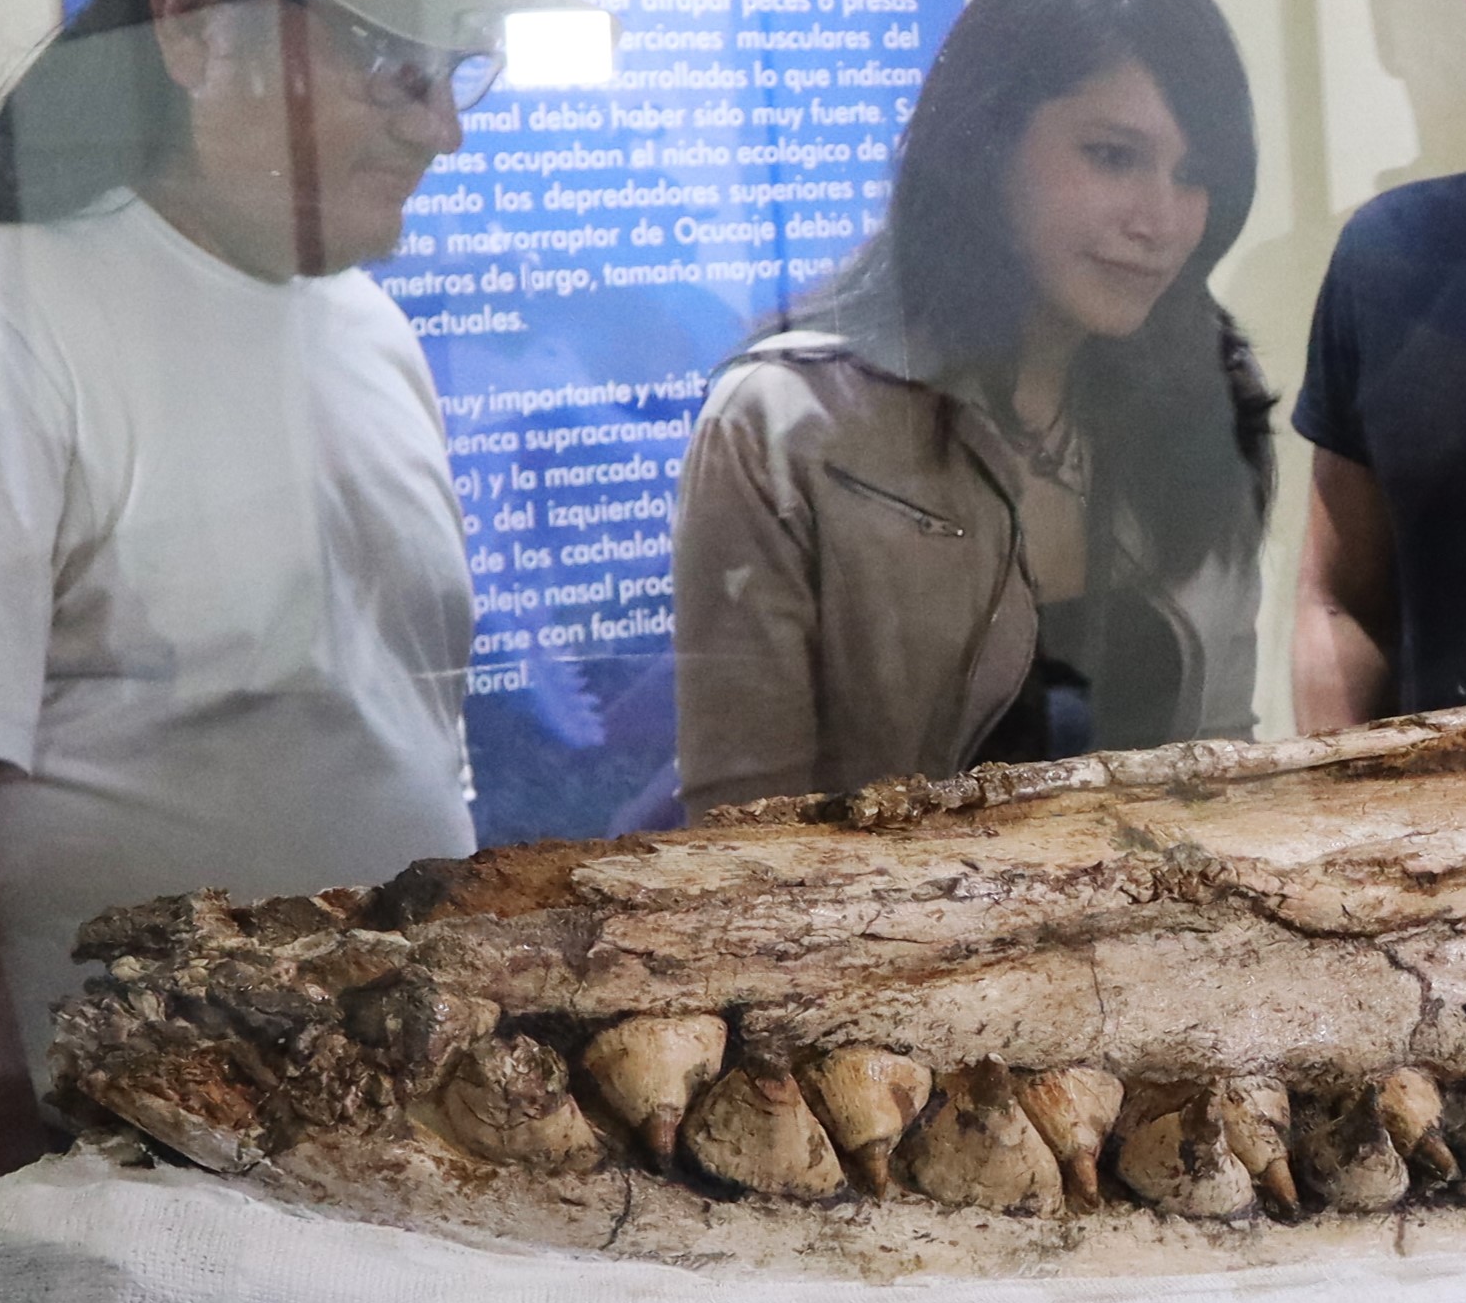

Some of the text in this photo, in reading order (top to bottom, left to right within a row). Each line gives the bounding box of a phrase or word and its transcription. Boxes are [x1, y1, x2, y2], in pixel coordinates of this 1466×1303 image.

[620, 22, 919, 51] erciones musculares del
[754, 60, 777, 88] lo
[784, 68, 830, 93] que
[837, 60, 923, 88] indican
[529, 102, 603, 131] debió
[610, 101, 686, 130] haber
[693, 99, 744, 127] sido
[752, 106, 804, 131] muy
[810, 97, 886, 126] fuerte.
[493, 141, 624, 177] ocupaban
[630, 140, 654, 169] el
[662, 138, 730, 167] nicho
[737, 136, 851, 170] ecológico
[857, 134, 887, 161] de
[402, 184, 483, 216] iendo
[494, 182, 532, 212] los
[543, 177, 719, 215] depredadores
[729, 175, 854, 209] superiores
[448, 224, 620, 254] macrorraptor
[631, 217, 664, 245] de
[674, 215, 776, 246] Ocucaje
[785, 212, 853, 239] debió
[383, 271, 475, 297] metros
[481, 264, 515, 292] de
[603, 259, 701, 286] tamaño
[706, 259, 782, 285] mayor
[788, 257, 833, 283] que
[489, 380, 631, 417] importante
[635, 383, 650, 408] y
[525, 410, 691, 454] supracraneal
[488, 473, 504, 498] y
[511, 463, 537, 490] la
[545, 454, 657, 488] marcada
[493, 502, 534, 532] del
[470, 531, 673, 574] de los cachalot
[544, 573, 614, 606] nasal
[537, 622, 584, 647] con
